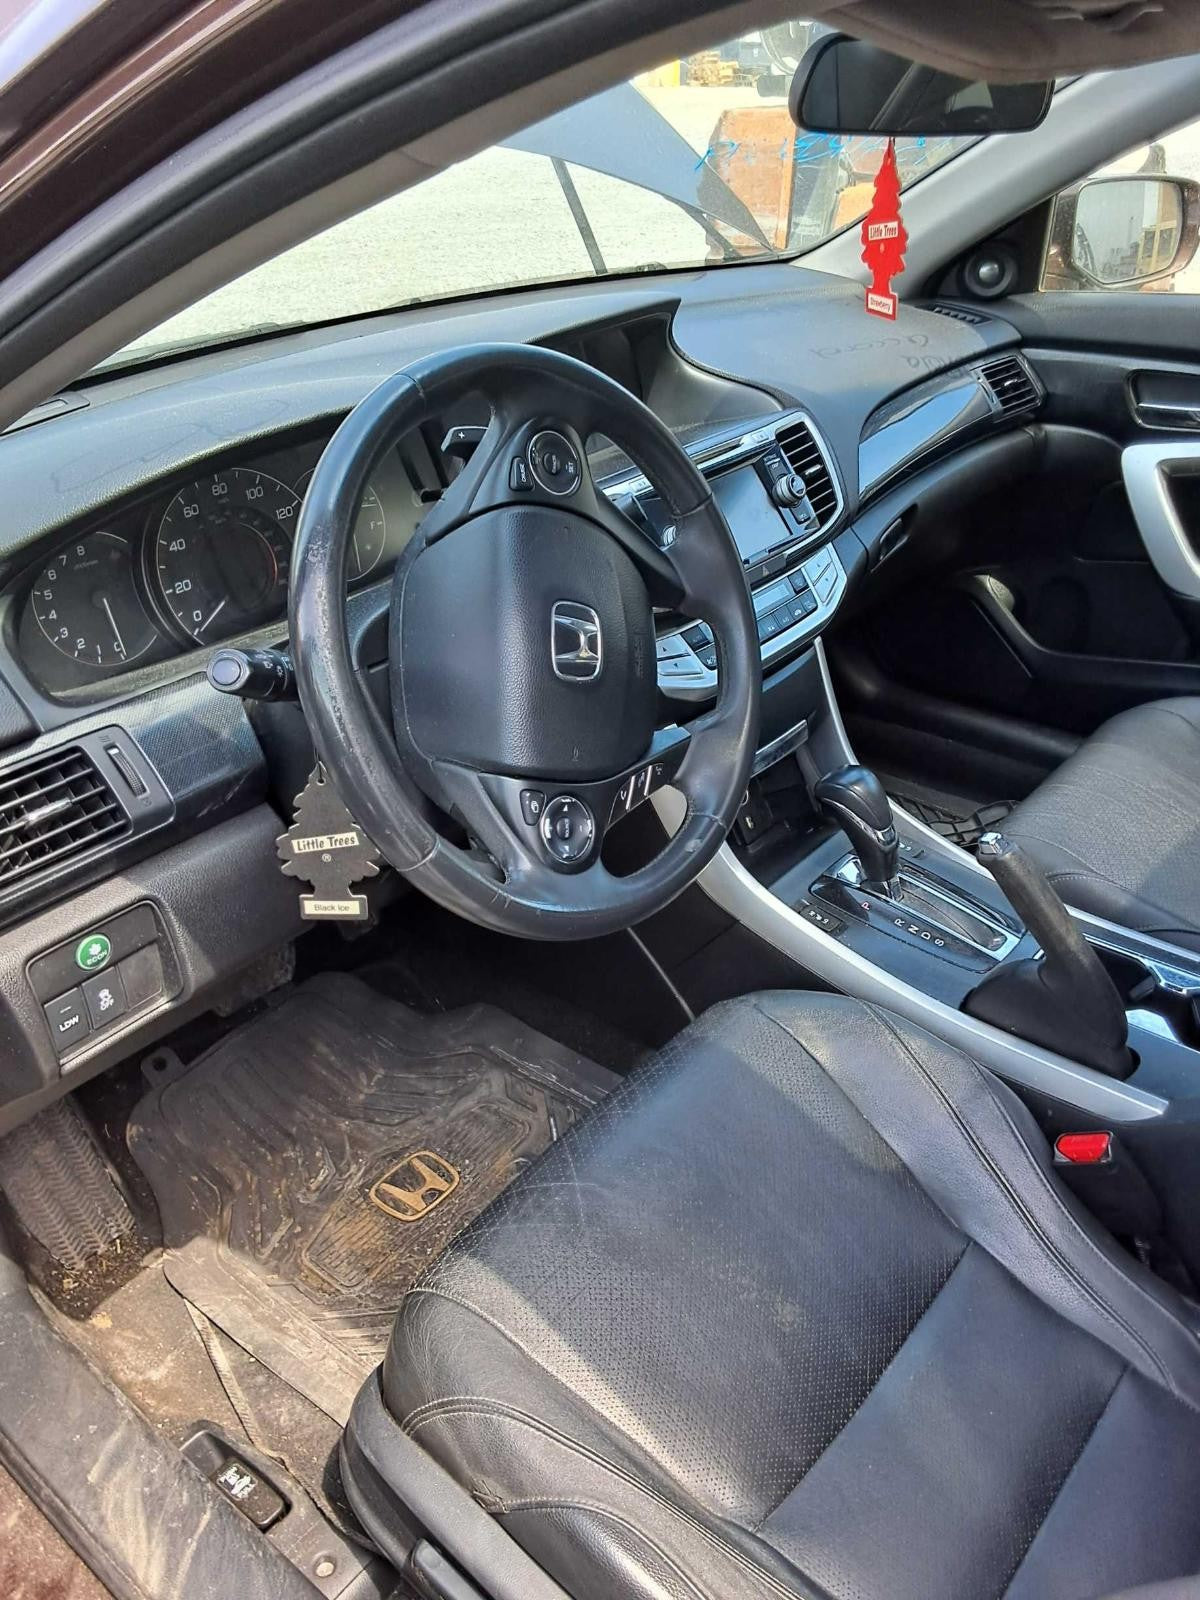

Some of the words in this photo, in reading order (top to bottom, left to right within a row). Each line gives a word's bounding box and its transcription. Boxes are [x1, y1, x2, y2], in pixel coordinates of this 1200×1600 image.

[870, 225, 883, 239] Little
[884, 224, 897, 237] Trees
[212, 482, 228, 496] 80
[246, 486, 264, 500] 100
[183, 503, 199, 518] 60
[275, 506, 294, 520] 120
[76, 545, 85, 556] 8
[169, 538, 186, 553] 40
[59, 555, 68, 566] 7
[47, 570, 57, 581] 6
[174, 579, 192, 594] 20
[43, 590, 53, 601] 5
[48, 609, 57, 620] 4
[193, 610, 202, 622] 0
[60, 627, 69, 639] 3
[76, 638, 86, 650] 2
[296, 838, 325, 852] Little
[327, 836, 356, 848] Trees
[314, 903, 335, 911] Black
[861, 902, 870, 911] P
[894, 918, 906, 927] R
[908, 924, 919, 934] N
[921, 931, 931, 941] D
[935, 938, 945, 947] S
[86, 950, 108, 965] ECON
[59, 1015, 79, 1032] LDW
